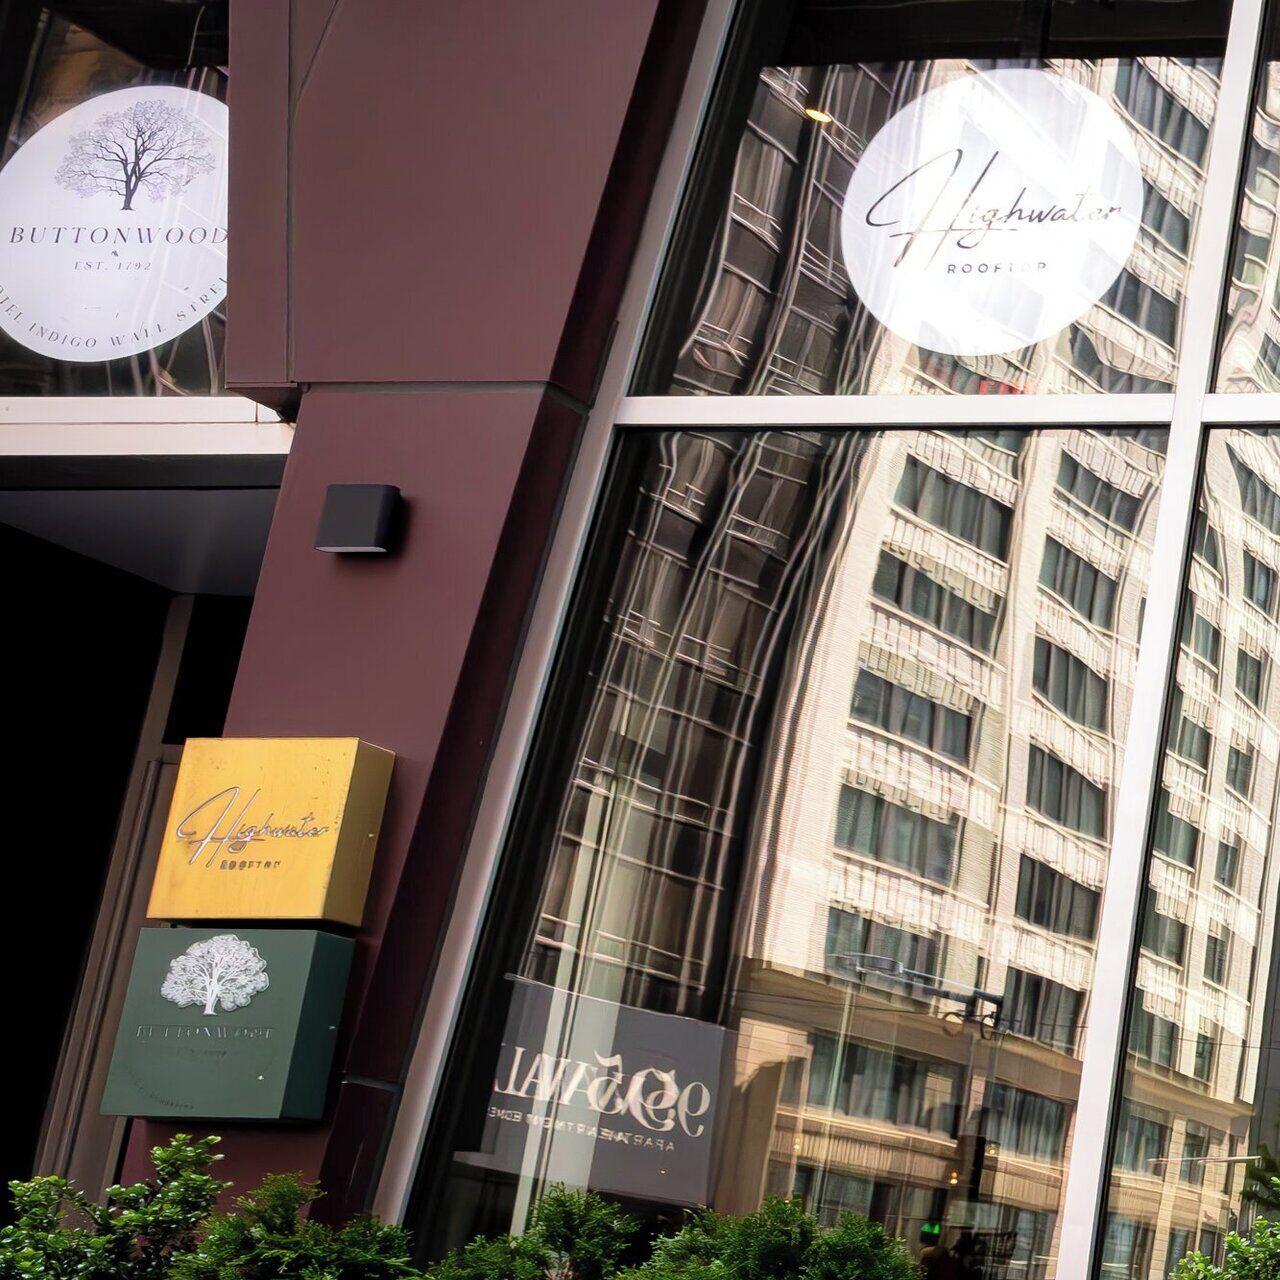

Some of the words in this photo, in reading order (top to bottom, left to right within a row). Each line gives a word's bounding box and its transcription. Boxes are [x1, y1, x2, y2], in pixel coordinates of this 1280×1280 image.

[866, 148, 1122, 271] Highwater
[29, 322, 97, 348] INDIGO
[110, 323, 167, 347] WALL
[176, 786, 329, 868] Highwater
